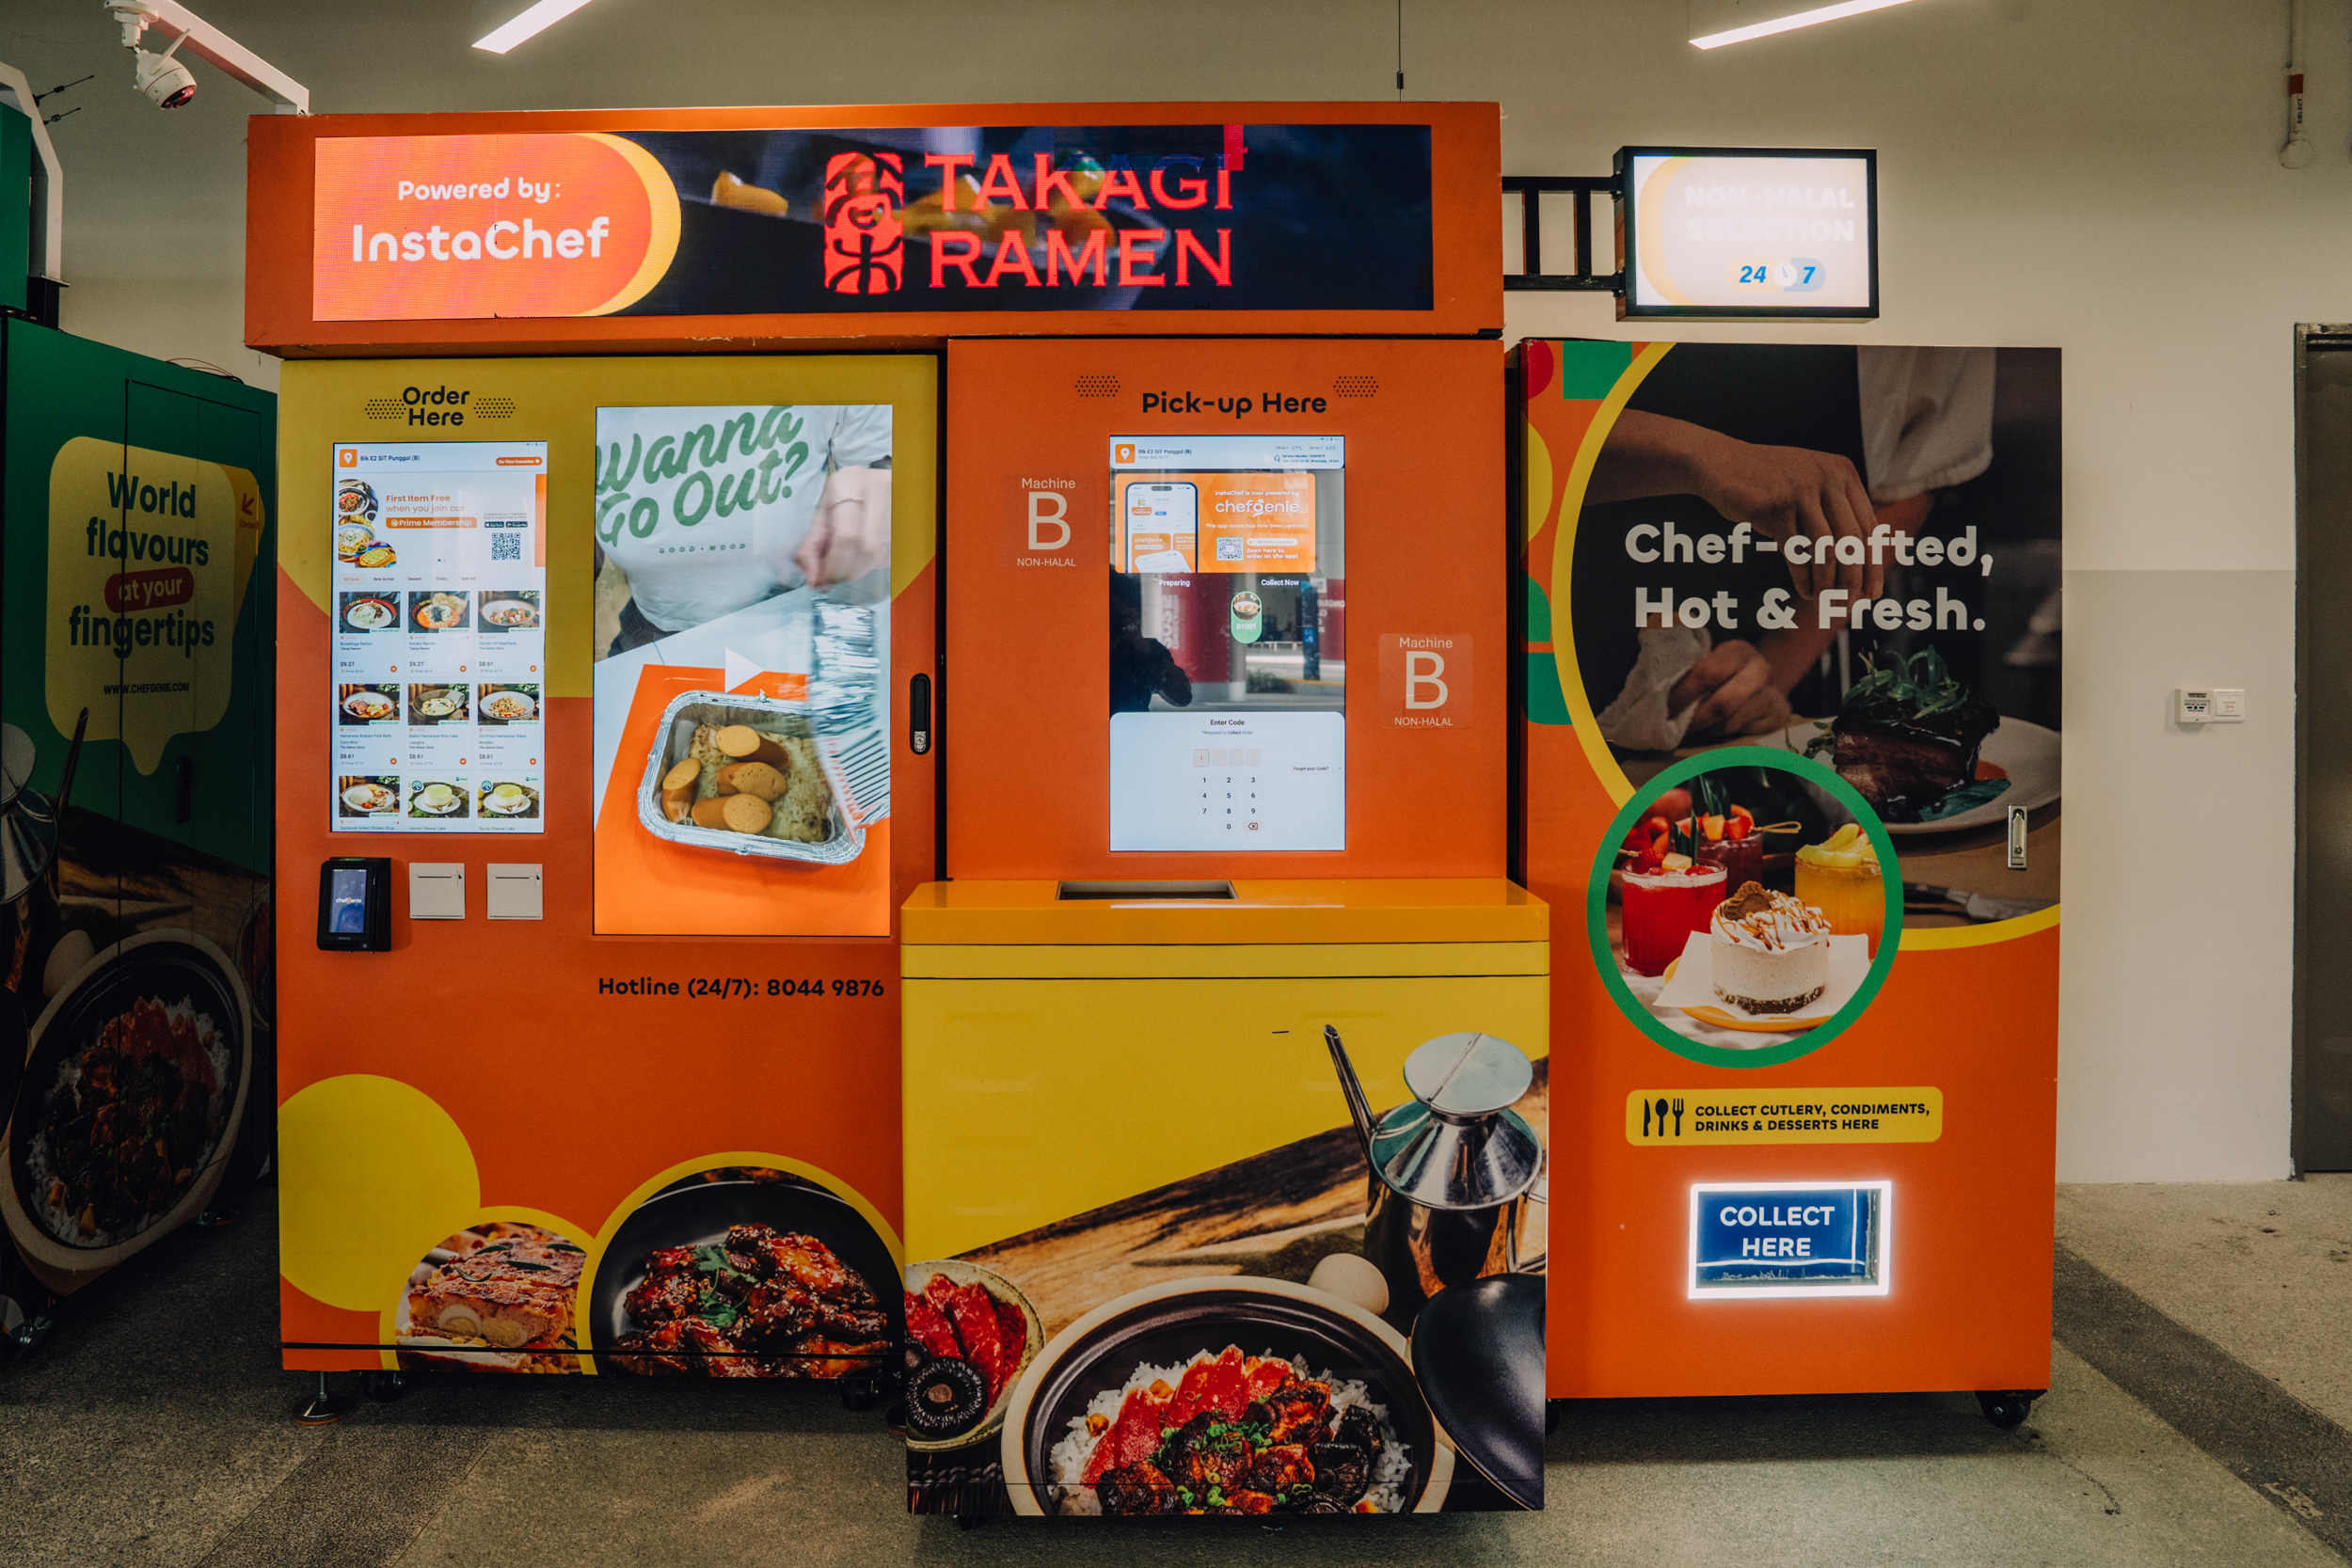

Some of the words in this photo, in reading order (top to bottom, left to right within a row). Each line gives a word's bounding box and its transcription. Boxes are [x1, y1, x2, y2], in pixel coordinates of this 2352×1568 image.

[398, 178, 510, 200] Powered
[517, 177, 561, 204] by:
[1685, 185, 1855, 209] NON-HALAL
[353, 216, 610, 262] InstaChef
[1685, 217, 1855, 243] SELECTION
[929, 228, 1234, 288] RAMEN
[1740, 265, 1767, 283] 24
[1803, 266, 1816, 284] 7
[403, 386, 469, 405] Order
[1142, 391, 1252, 419] Pick-up
[1263, 392, 1327, 413] Here
[408, 408, 464, 426] Here
[596, 492, 660, 547] Go
[673, 441, 809, 527] Out?
[1021, 477, 1076, 490] Machine
[107, 472, 196, 519] World
[431, 505, 448, 514] join
[1216, 499, 1299, 518] chefgenie
[239, 519, 259, 531] (Order)
[1028, 492, 1072, 550] B
[87, 516, 209, 566] flavours
[1625, 521, 1994, 577] Chef-crafted,
[1017, 558, 1076, 567] NON-HALAL
[119, 580, 139, 602] at
[142, 576, 183, 606] your
[1159, 579, 1190, 588] Preparing
[1634, 586, 1739, 629] Hot
[1756, 589, 1800, 629] &
[1818, 586, 1986, 631] Fresh.
[69, 604, 215, 658] fingertips
[1399, 637, 1453, 650] Machine
[103, 682, 189, 695] WWW.CHEFGENIE.COM
[1406, 651, 1449, 710] B
[1394, 717, 1454, 726] NON-HALAL
[598, 978, 680, 996] Hotline
[687, 978, 760, 1000] (24/7):
[767, 979, 825, 997] 8044
[832, 979, 885, 998] 9876
[1694, 1104, 1757, 1117] COLLECT
[1760, 1103, 1827, 1117] CUTLERY,
[1831, 1102, 1931, 1117] CONDIMENTS,
[1694, 1120, 1749, 1132] DRINKS
[1753, 1120, 1763, 1132] &
[1768, 1119, 1838, 1132] DESSERTS
[1842, 1119, 1880, 1130] HERE
[1720, 1206, 1836, 1227] COLLECT
[1742, 1238, 1811, 1257] HERE
